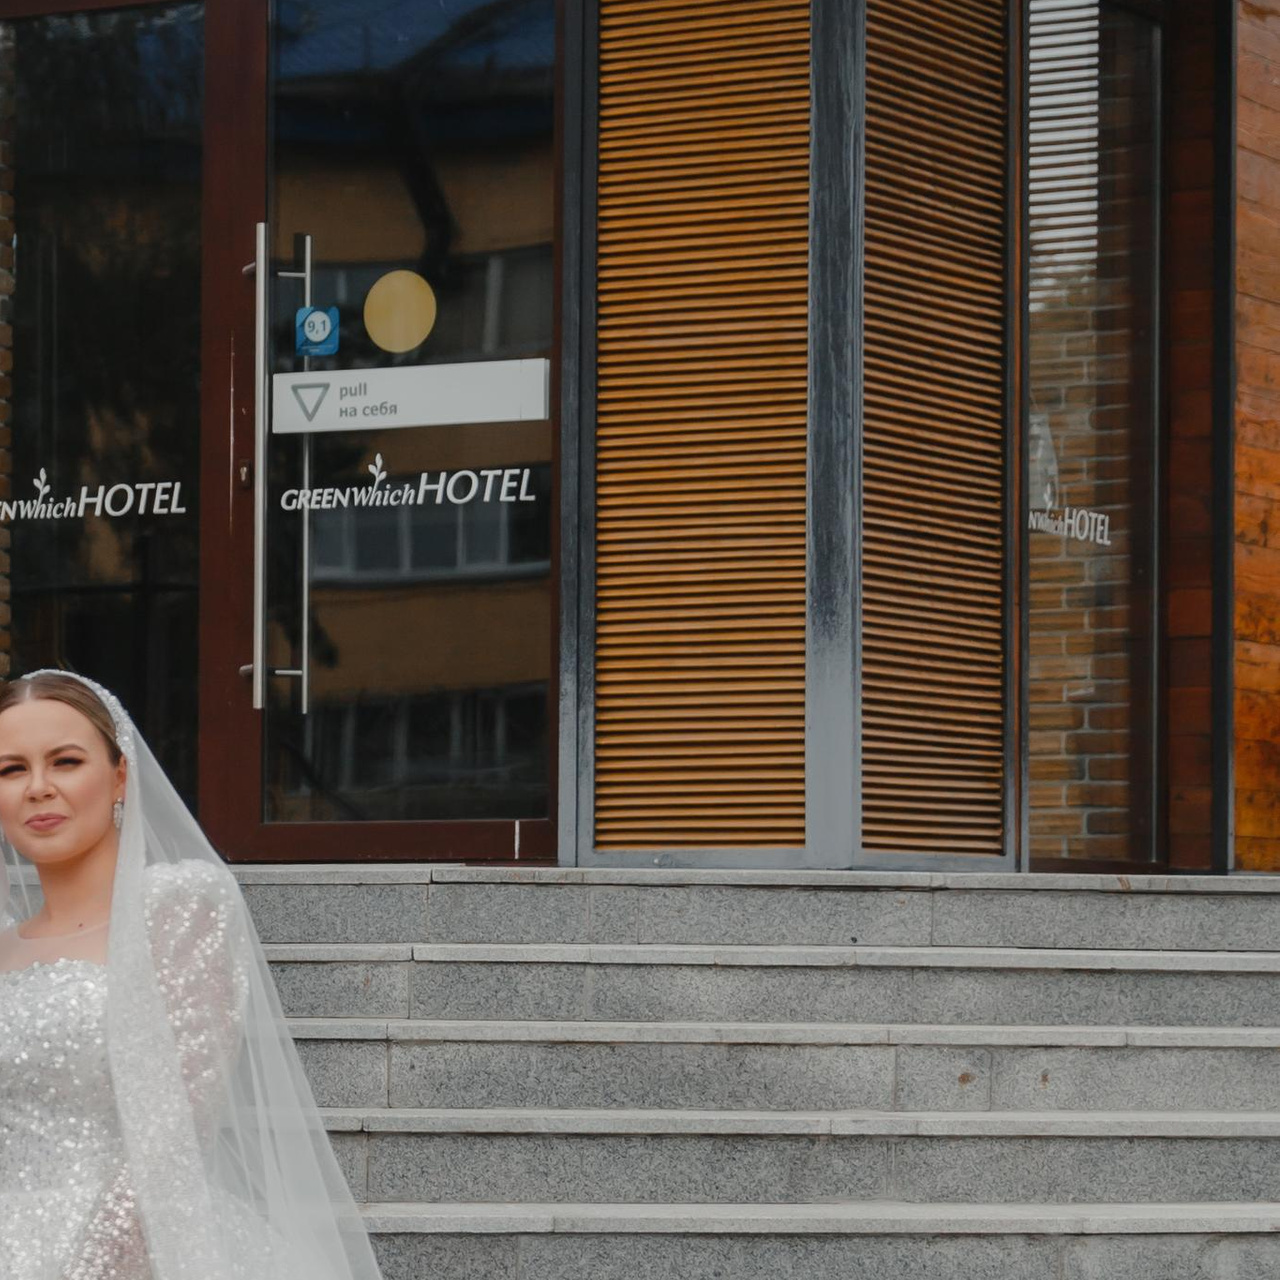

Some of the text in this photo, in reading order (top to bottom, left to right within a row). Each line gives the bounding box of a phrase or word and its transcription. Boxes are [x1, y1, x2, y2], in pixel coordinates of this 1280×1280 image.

[339, 382, 368, 401] pull
[339, 401, 398, 418] на себя
